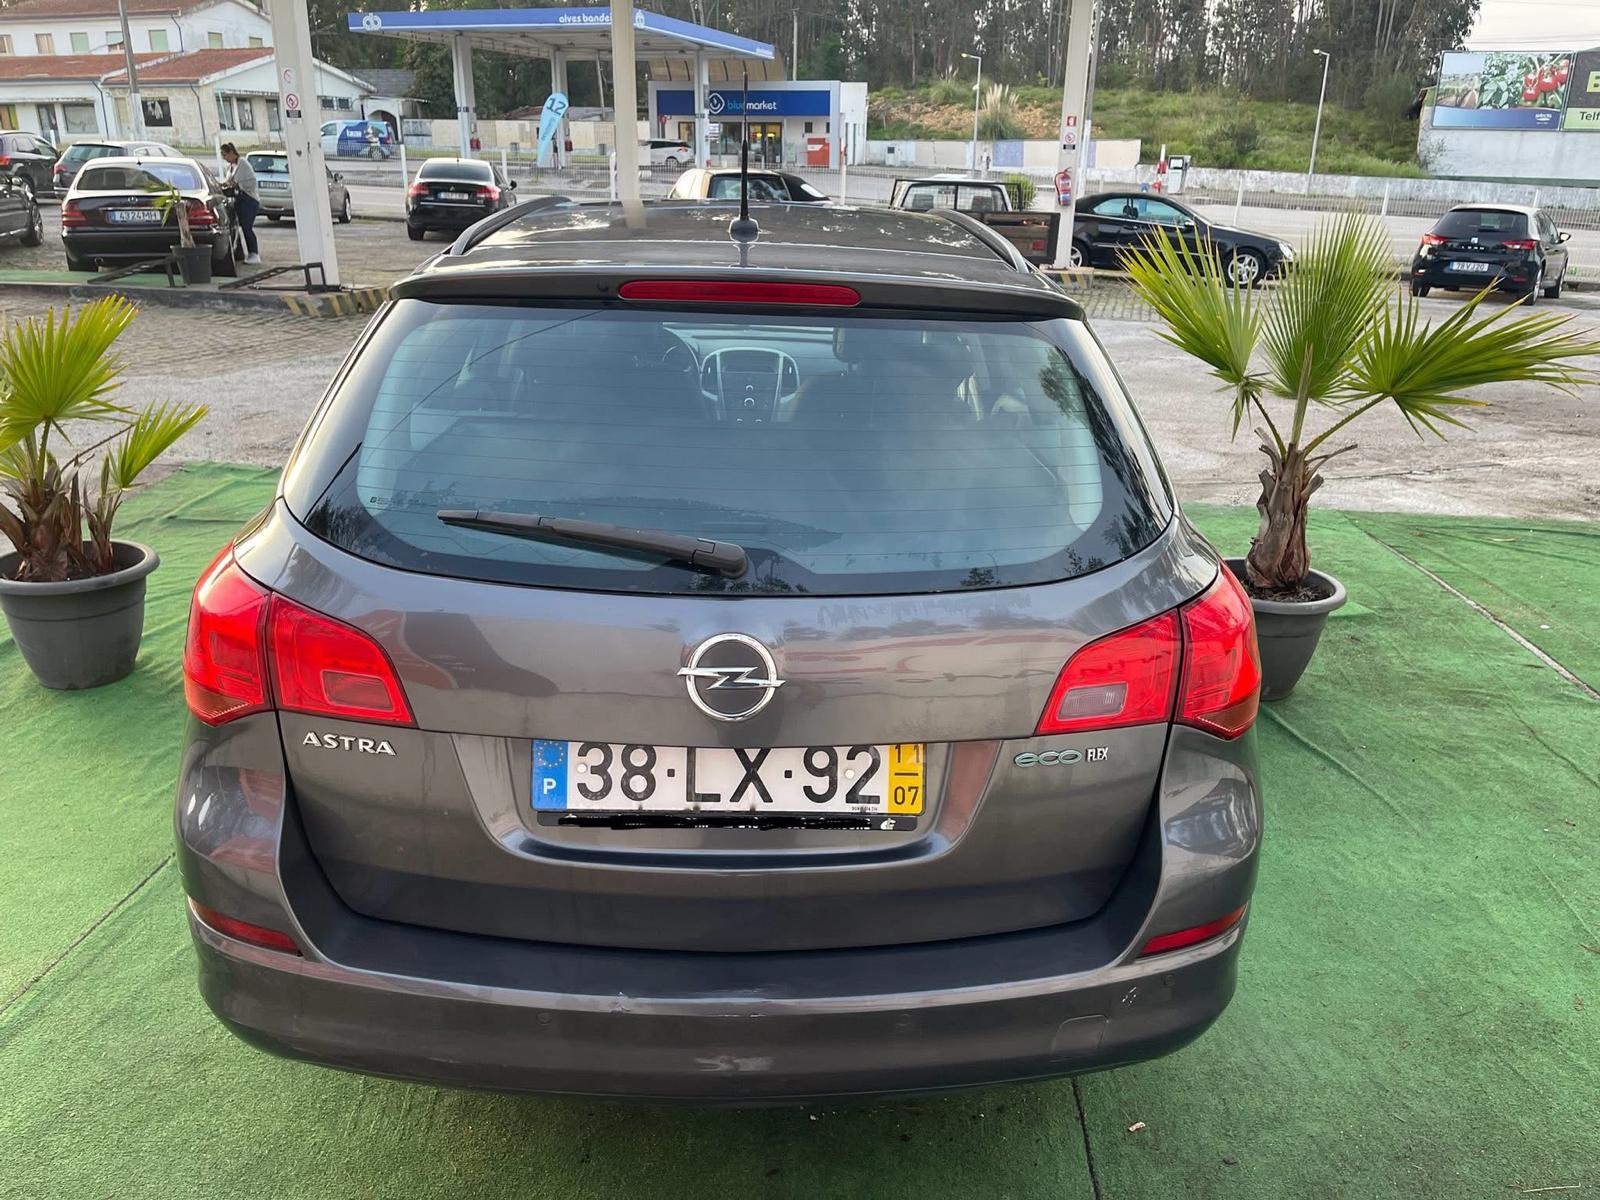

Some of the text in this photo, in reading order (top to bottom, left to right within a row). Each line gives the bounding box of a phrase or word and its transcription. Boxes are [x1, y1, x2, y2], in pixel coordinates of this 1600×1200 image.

[559, 13, 582, 23] alves
[546, 98, 566, 116] 12
[303, 732, 396, 756] ASTRA
[895, 744, 920, 763] 11
[1087, 748, 1108, 762] FLEX
[543, 778, 557, 794] P
[894, 786, 919, 805] 07
